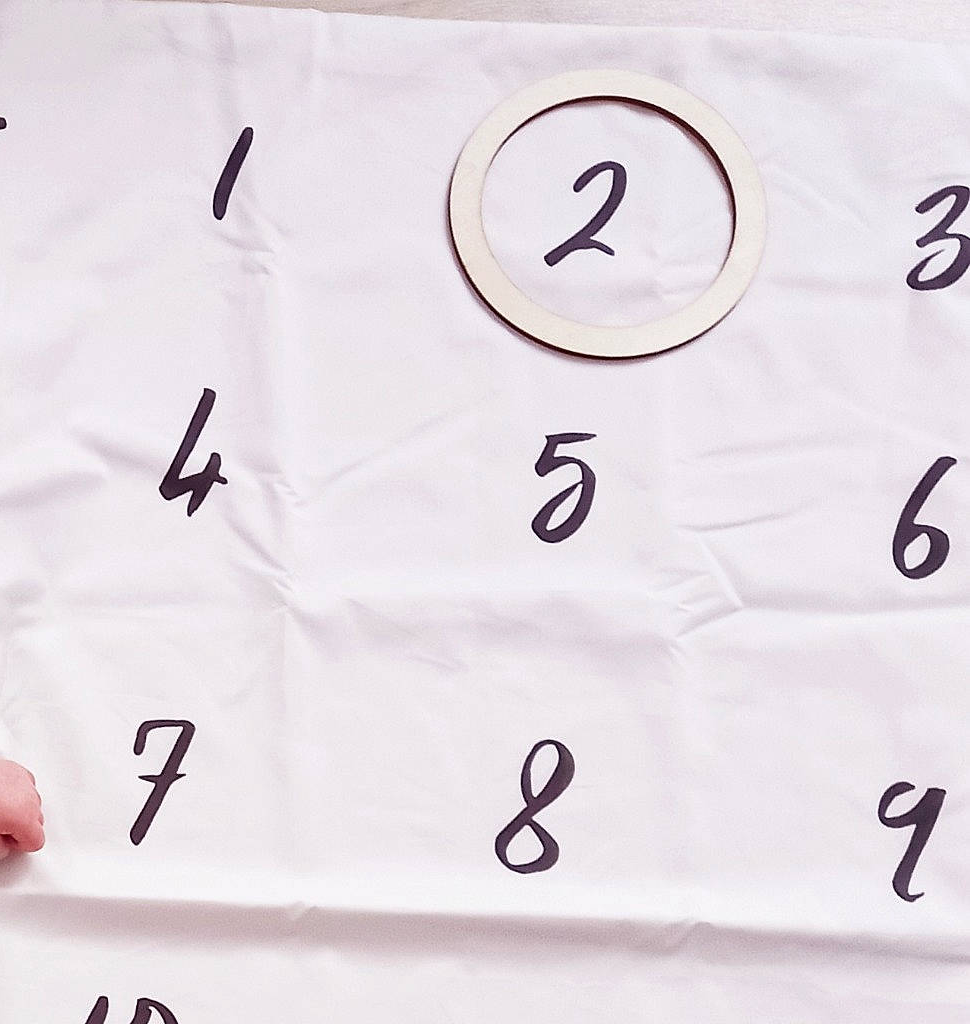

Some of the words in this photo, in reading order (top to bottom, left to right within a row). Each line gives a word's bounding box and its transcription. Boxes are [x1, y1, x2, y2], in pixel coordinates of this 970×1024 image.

[212, 126, 254, 221] 1
[543, 160, 627, 267] 2
[906, 185, 970, 291] 3
[158, 387, 228, 518] 4
[531, 432, 597, 544] 5
[892, 456, 957, 580] 6
[129, 719, 196, 846] 7
[494, 739, 575, 875] 8
[877, 781, 947, 903] 9
